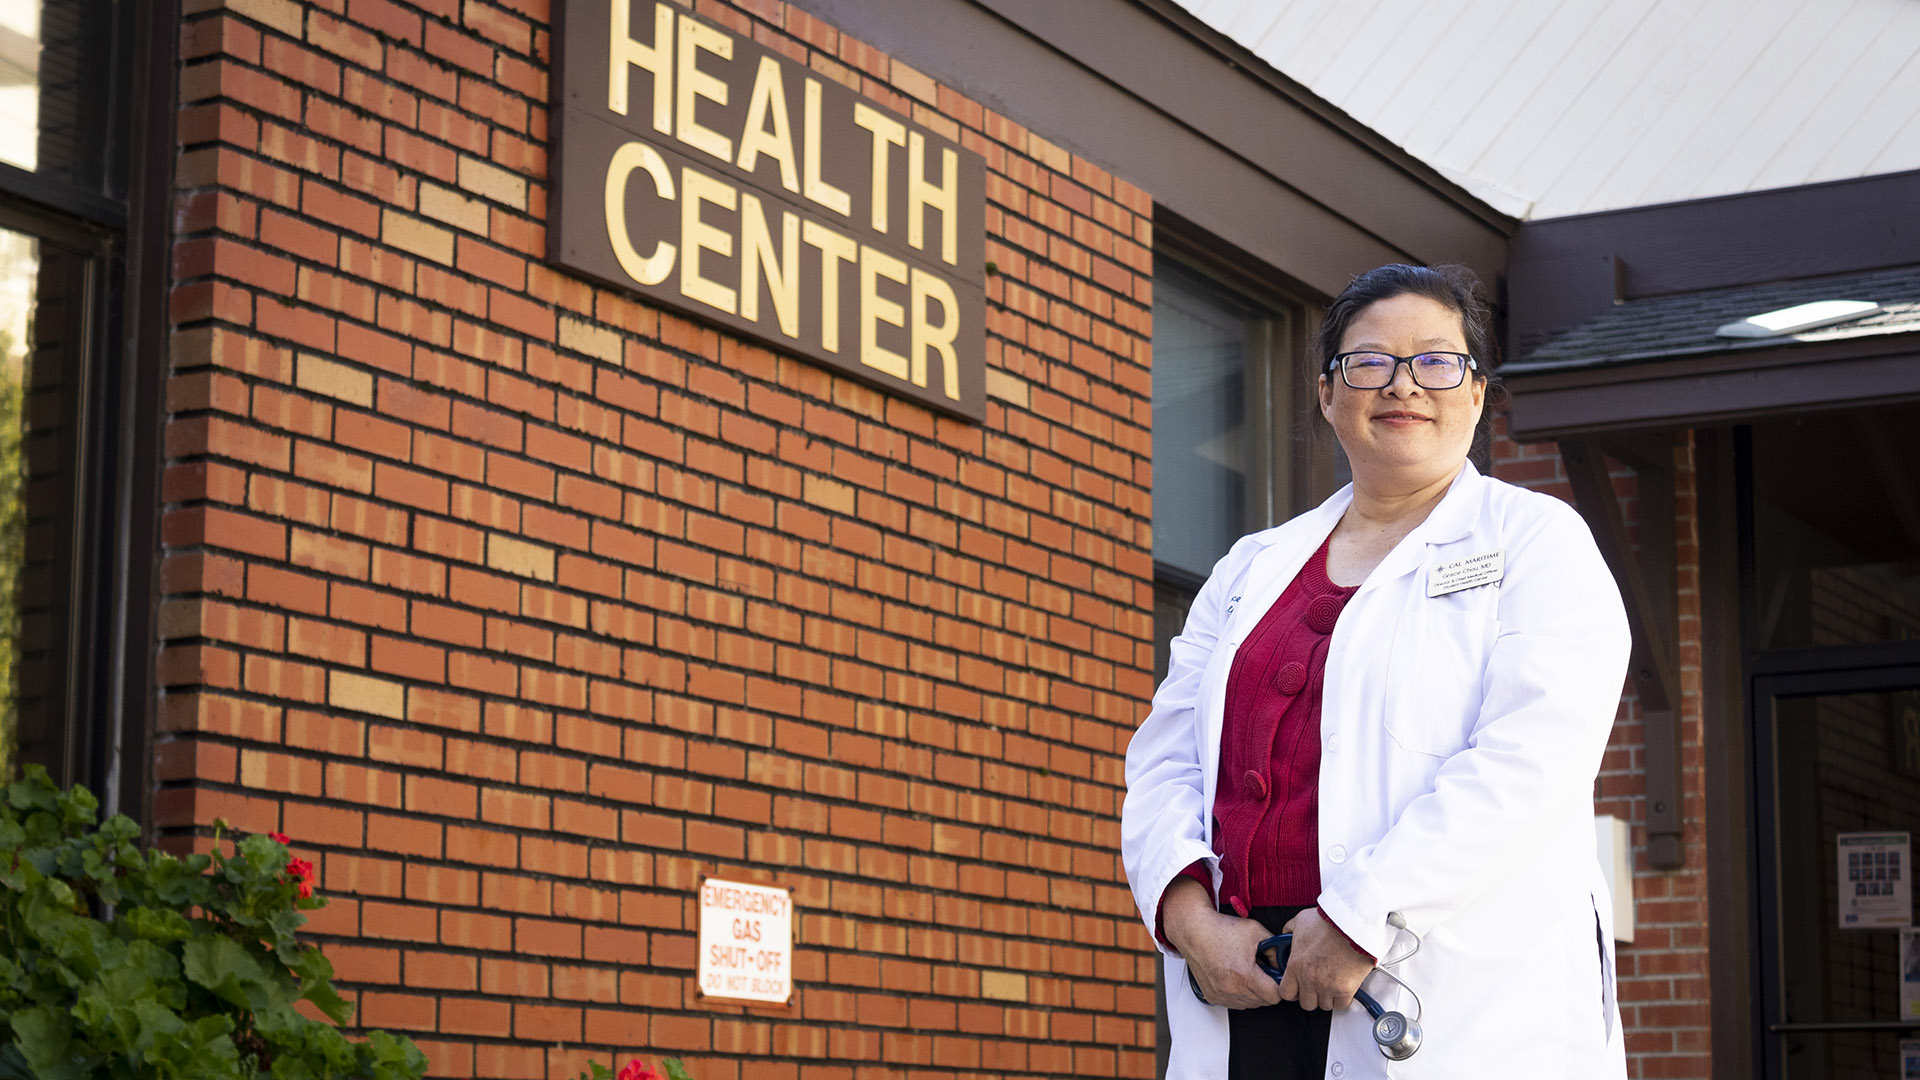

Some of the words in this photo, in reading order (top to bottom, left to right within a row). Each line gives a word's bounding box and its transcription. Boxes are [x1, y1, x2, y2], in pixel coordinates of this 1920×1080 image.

[608, 0, 958, 266] HEALTH
[605, 141, 960, 401] CENTER
[1464, 552, 1499, 565] MARITIME
[1442, 571, 1461, 579] Grace
[704, 886, 786, 917] EMERGENCY
[733, 918, 761, 942] GAS
[710, 944, 782, 973] SHUT-OFF
[706, 973, 722, 990] DO
[727, 975, 748, 993] NOT
[751, 978, 784, 996] BLOCK
